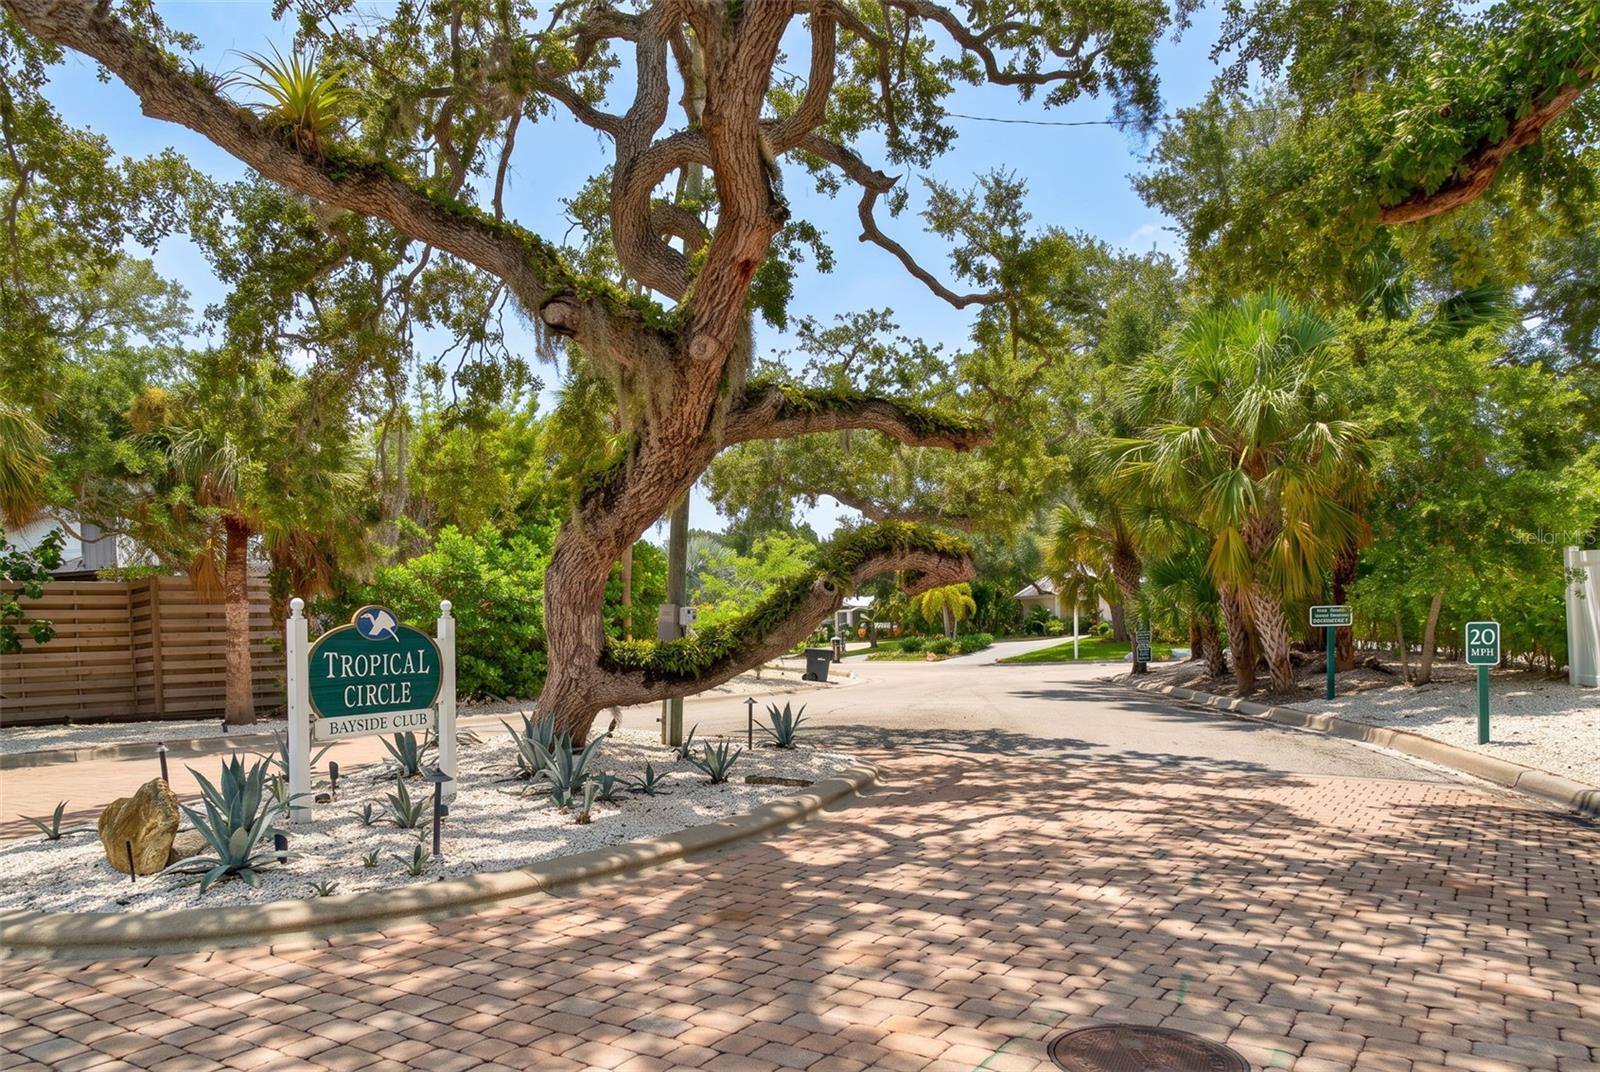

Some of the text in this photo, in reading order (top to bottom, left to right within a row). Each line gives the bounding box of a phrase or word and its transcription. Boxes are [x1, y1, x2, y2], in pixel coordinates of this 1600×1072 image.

[1470, 628, 1496, 645] 20
[1471, 647, 1494, 656] MPH
[323, 649, 430, 678] TROPICAL
[344, 682, 412, 708] CIRCLE
[330, 713, 428, 735] BAYSIDE CLUB
